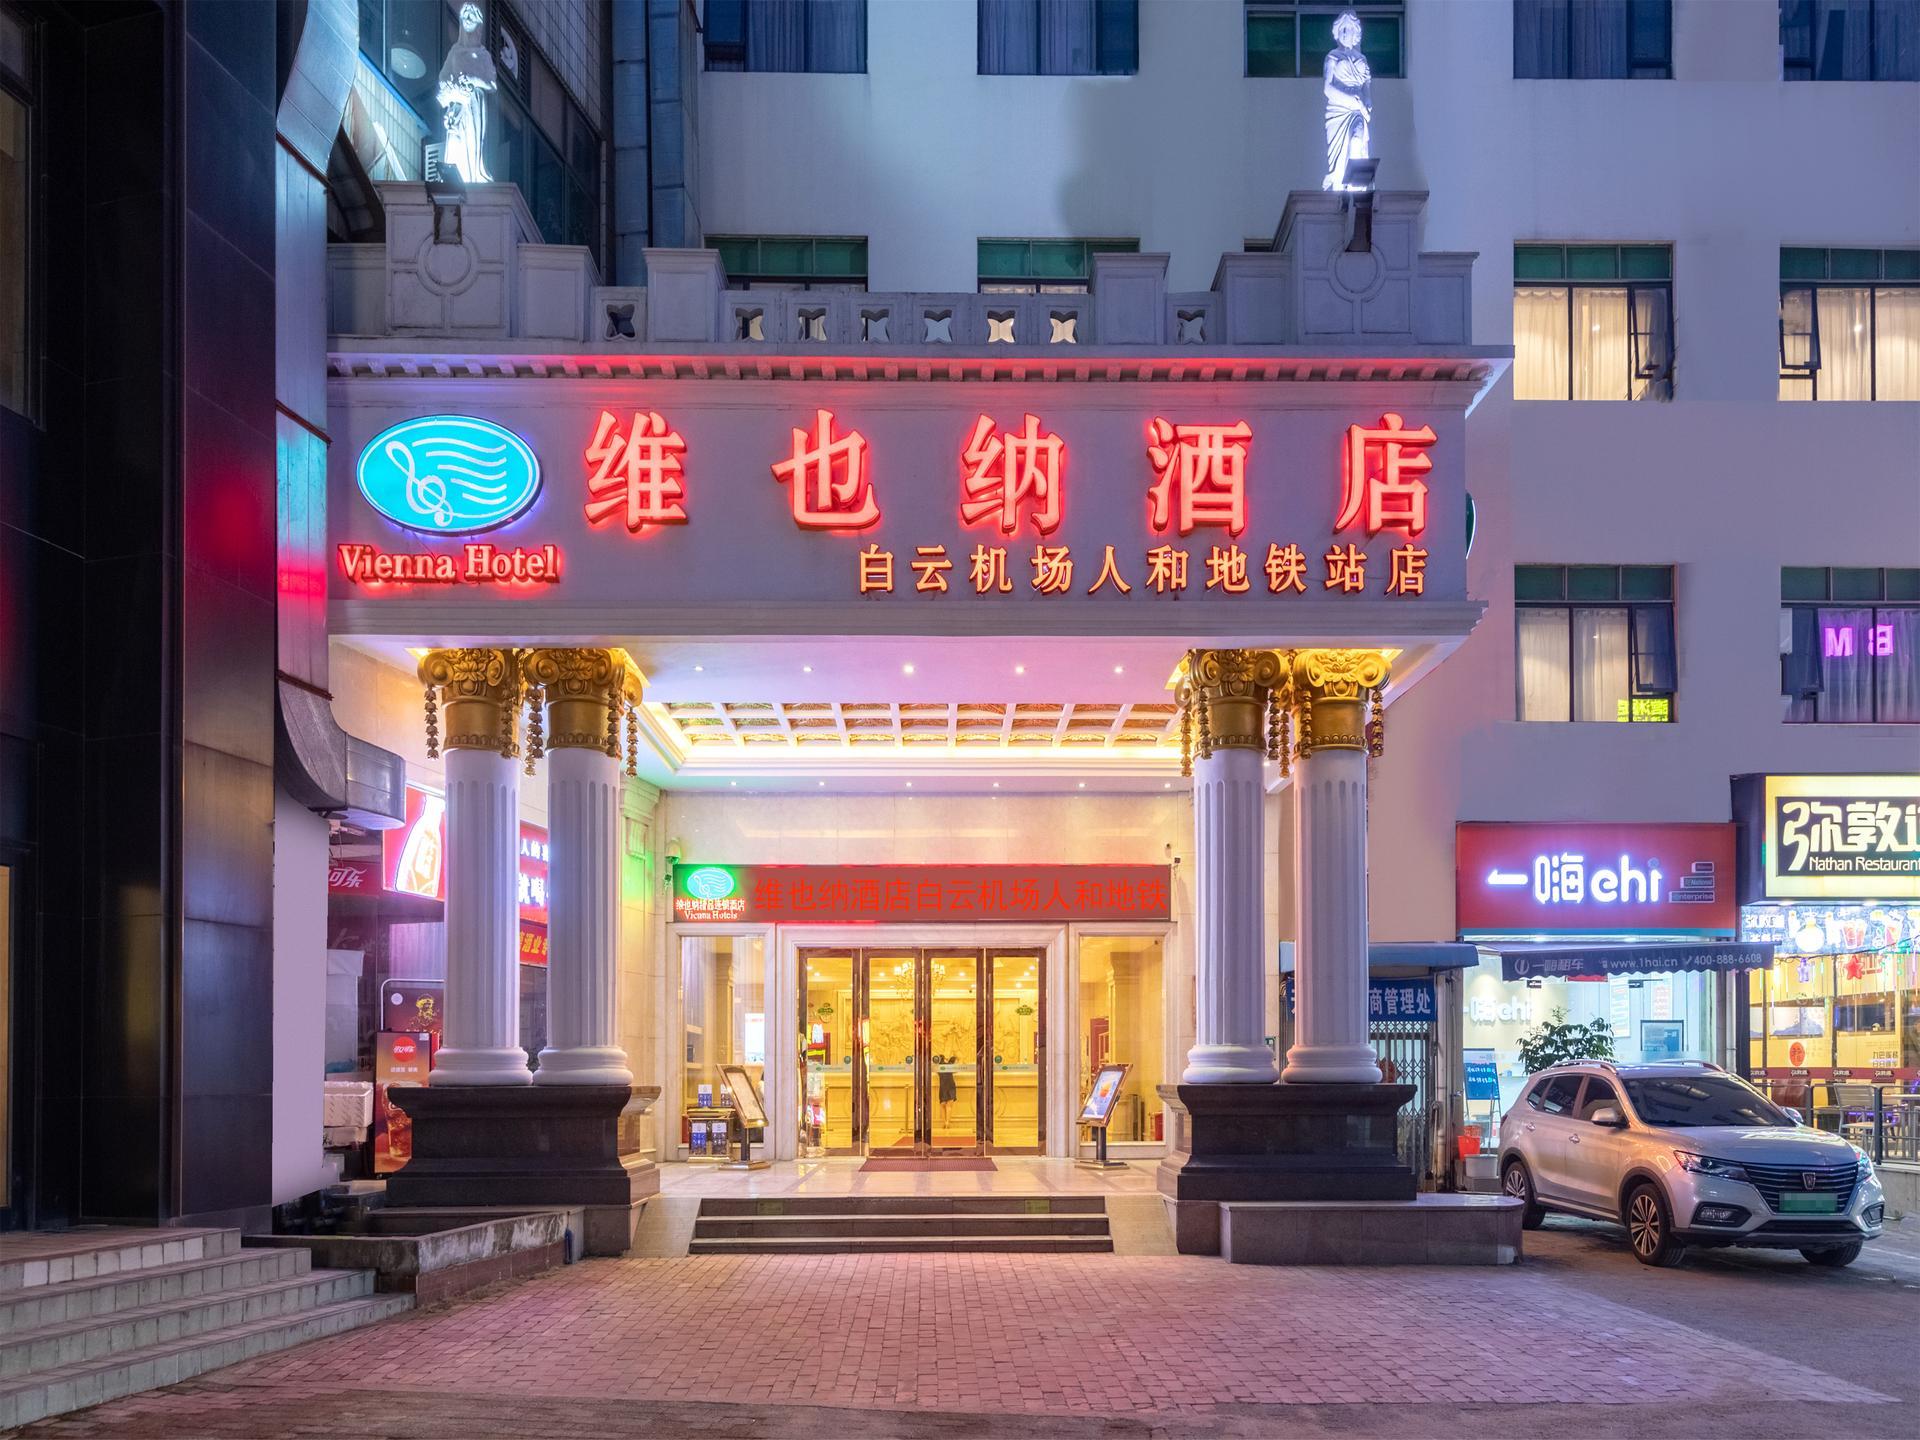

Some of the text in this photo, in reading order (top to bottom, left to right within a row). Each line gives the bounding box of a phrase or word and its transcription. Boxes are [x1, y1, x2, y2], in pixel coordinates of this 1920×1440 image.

[584, 408, 1438, 536] 维也纳酒店
[338, 544, 559, 584] Vienna Hotel
[859, 543, 1429, 596] 白云机场人和地铁站店
[328, 866, 368, 888] 可乐
[1809, 855, 1852, 871] Nathan
[754, 878, 1168, 912] 维也纳酒店白云机场人和地铁
[1609, 953, 1762, 968] www.1hai.cn 400-888-6608
